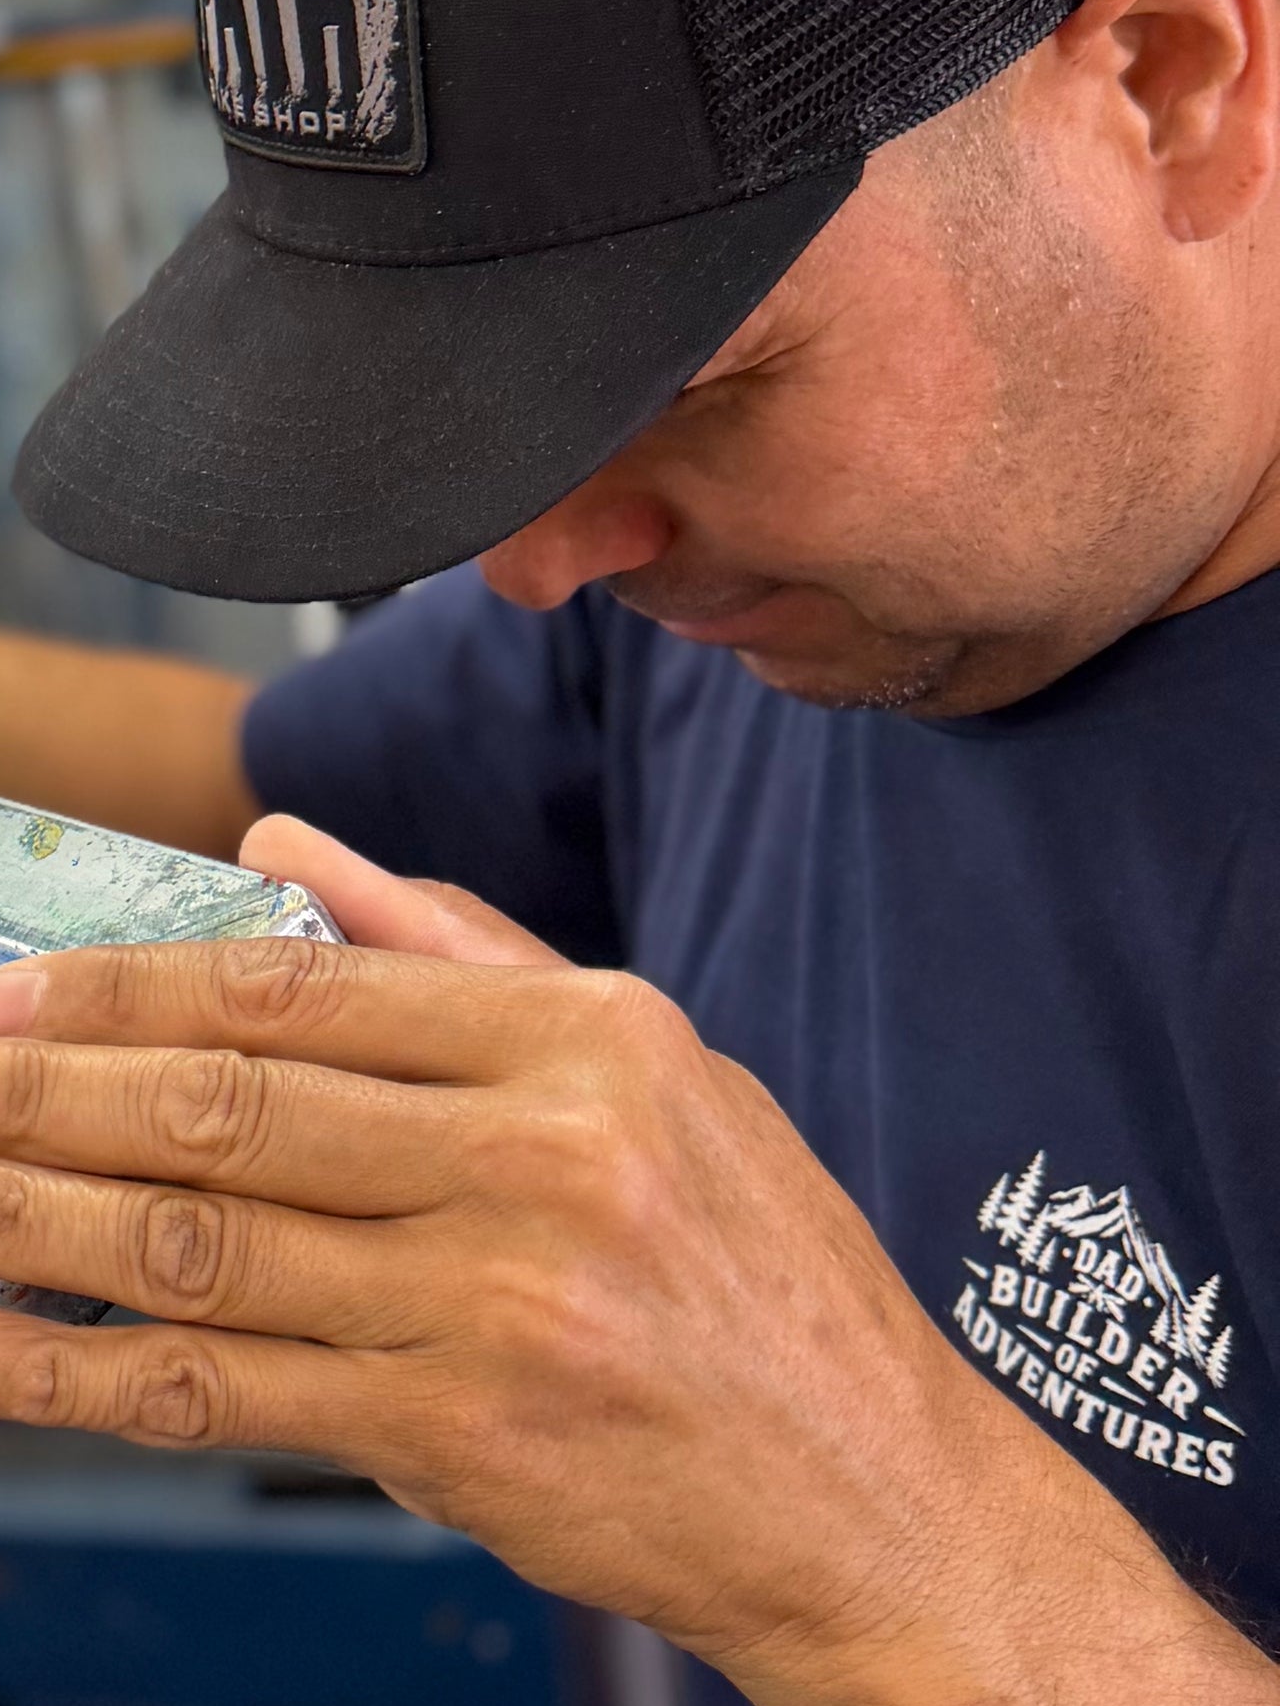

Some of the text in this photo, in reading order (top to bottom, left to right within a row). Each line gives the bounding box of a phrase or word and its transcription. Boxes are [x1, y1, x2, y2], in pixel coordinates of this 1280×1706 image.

[255, 104, 347, 141] SHOP
[1073, 1239, 1145, 1303] DAD
[989, 1263, 1200, 1422] BUILDER
[1055, 1345, 1099, 1383] OF
[952, 1282, 1235, 1487] ADVENTURES
